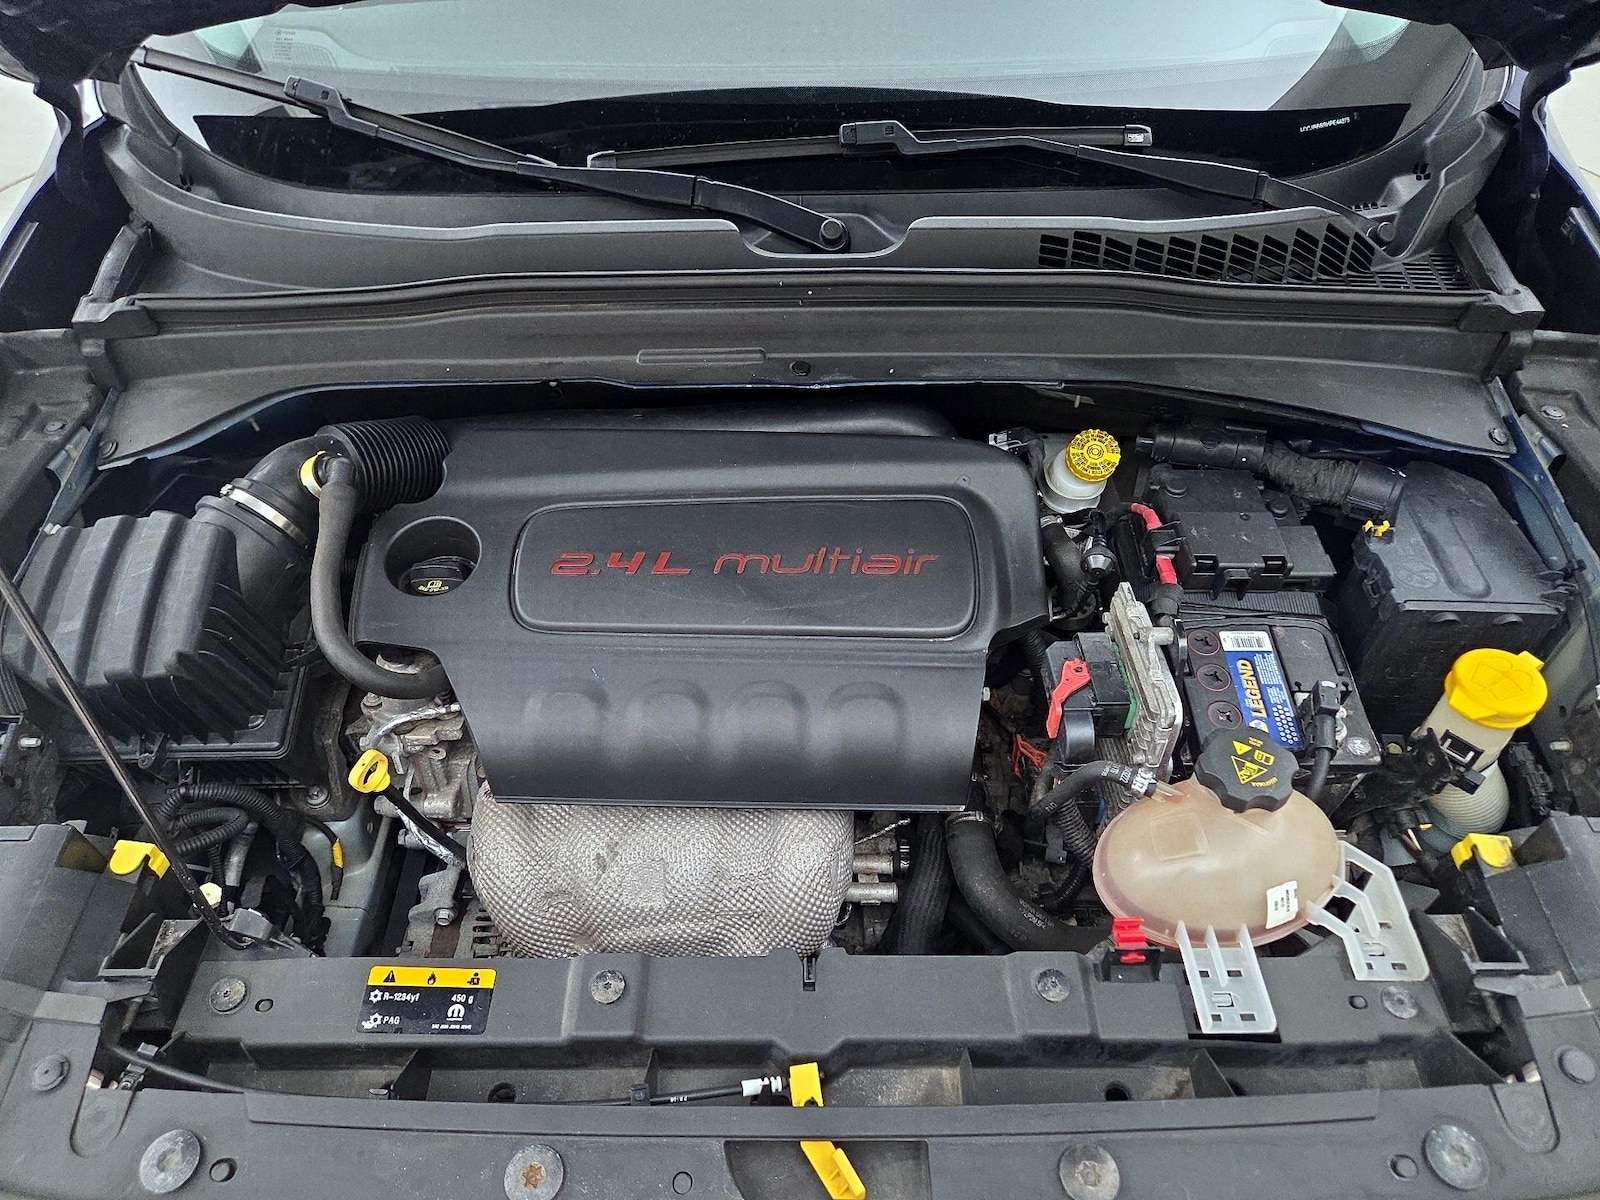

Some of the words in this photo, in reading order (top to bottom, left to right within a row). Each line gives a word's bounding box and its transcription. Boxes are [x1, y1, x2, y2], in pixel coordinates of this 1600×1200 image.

[713, 547, 940, 575] multiair
[1236, 659, 1268, 718] LEGEND
[451, 994, 466, 1003] 450
[468, 995, 474, 1004] g
[383, 1015, 400, 1025] PAG
